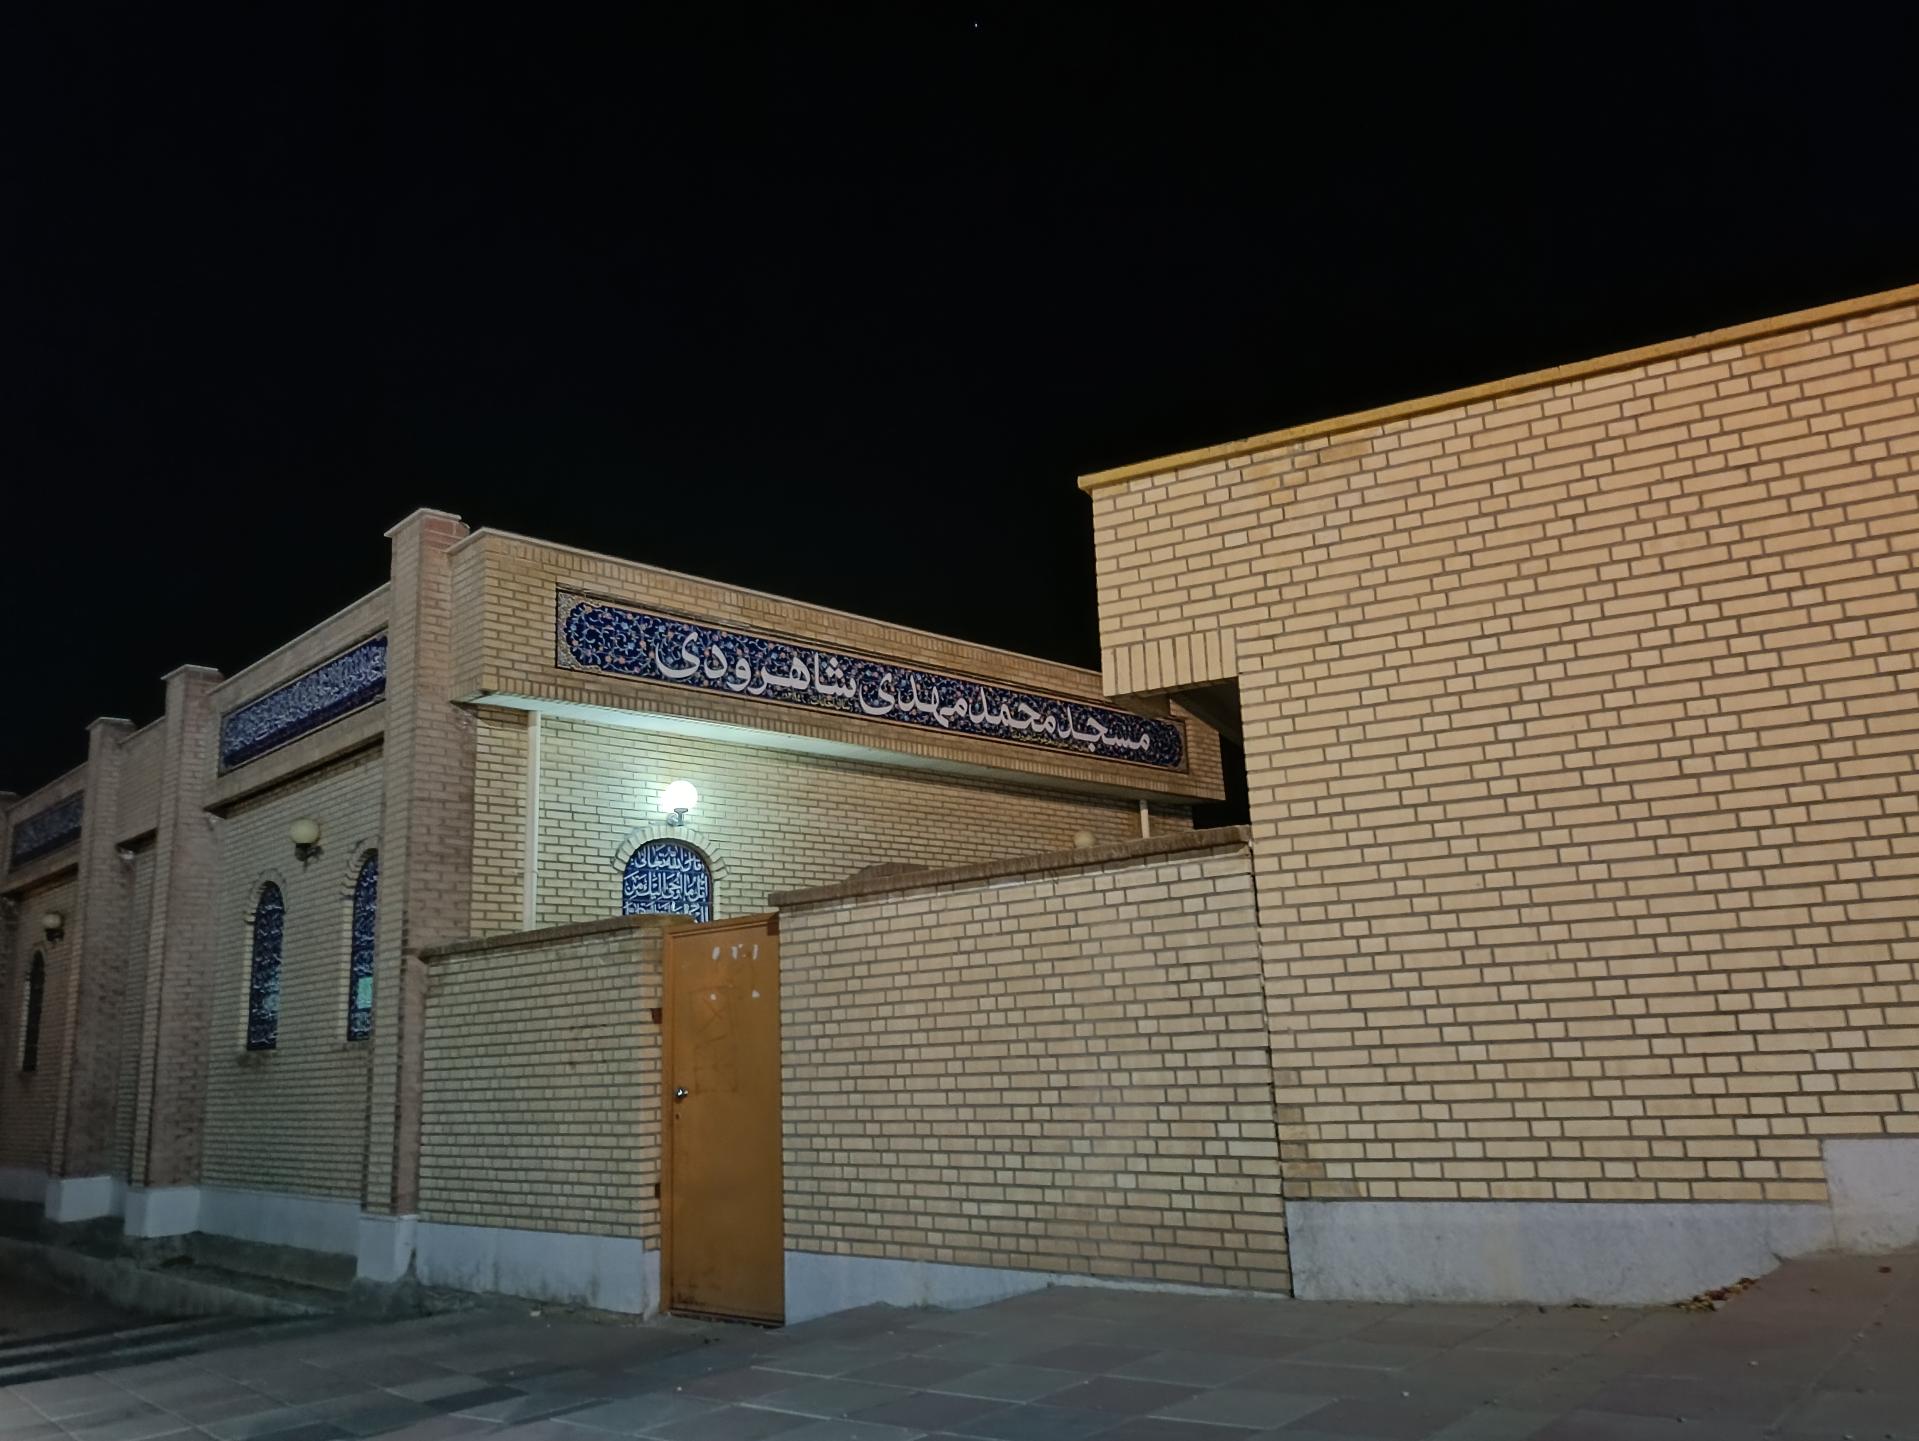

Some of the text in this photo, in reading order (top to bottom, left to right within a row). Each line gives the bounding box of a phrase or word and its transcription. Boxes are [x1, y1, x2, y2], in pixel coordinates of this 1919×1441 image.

[655, 632, 1150, 752] مسجد محمد مهدی شاهرودی
